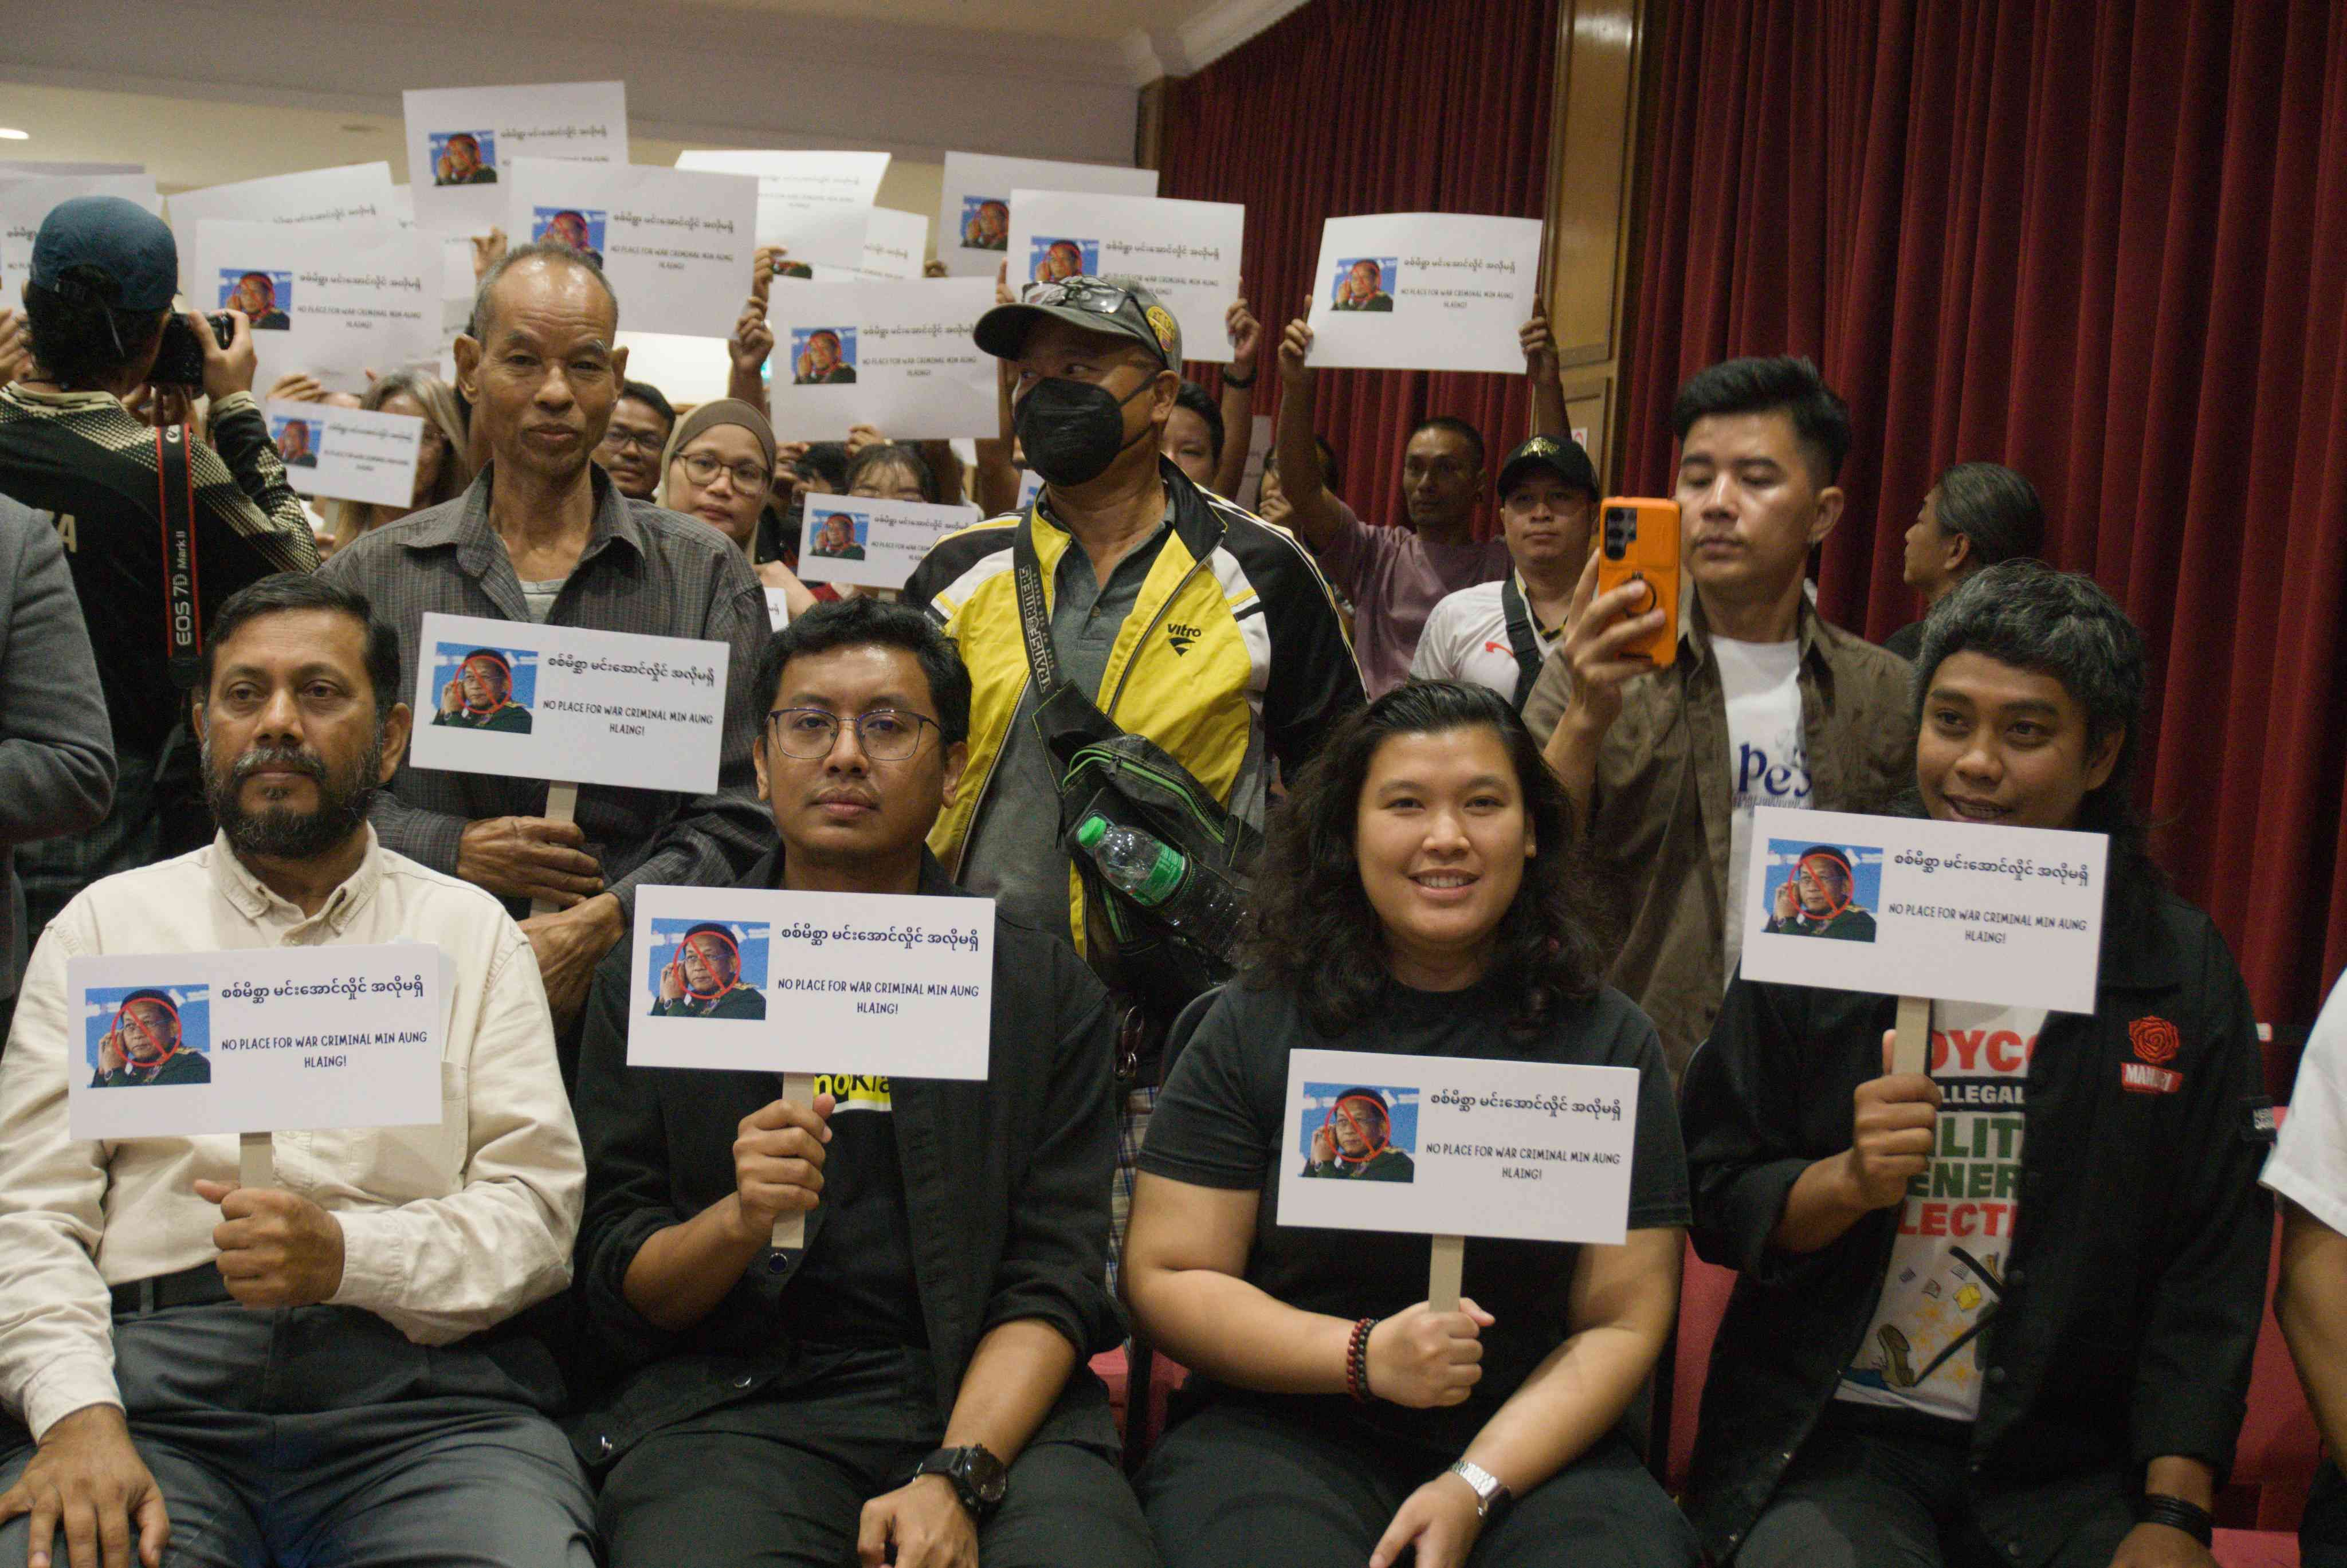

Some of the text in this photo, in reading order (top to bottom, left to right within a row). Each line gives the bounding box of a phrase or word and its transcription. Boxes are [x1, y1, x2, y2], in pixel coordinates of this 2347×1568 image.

[176, 540, 187, 569] Mark
[172, 573, 189, 596] 7D
[175, 601, 191, 646] EOS
[543, 700, 713, 724] NO PLACE FOR WAR CRIMINAL MIN AUNG
[610, 723, 645, 736] HLAING!
[1889, 903, 2086, 930] NO PLACE FOR WAR CRIMINAL MIN AUNG
[1965, 930, 2006, 944] HLAING!
[778, 979, 979, 996] NO PLACE FOR WAR CRIMINAL MIN AUNG
[857, 1003, 898, 1014] HLAING!
[222, 1032, 427, 1050] NO PLACE FOR WAR CRIMINAL MIN AUNG
[304, 1056, 347, 1068] HLAING!
[1427, 1143, 1620, 1164] NO PLACE FOR WAR CRIMINAL MIN AUNG
[1502, 1167, 1542, 1180] HLAING!
